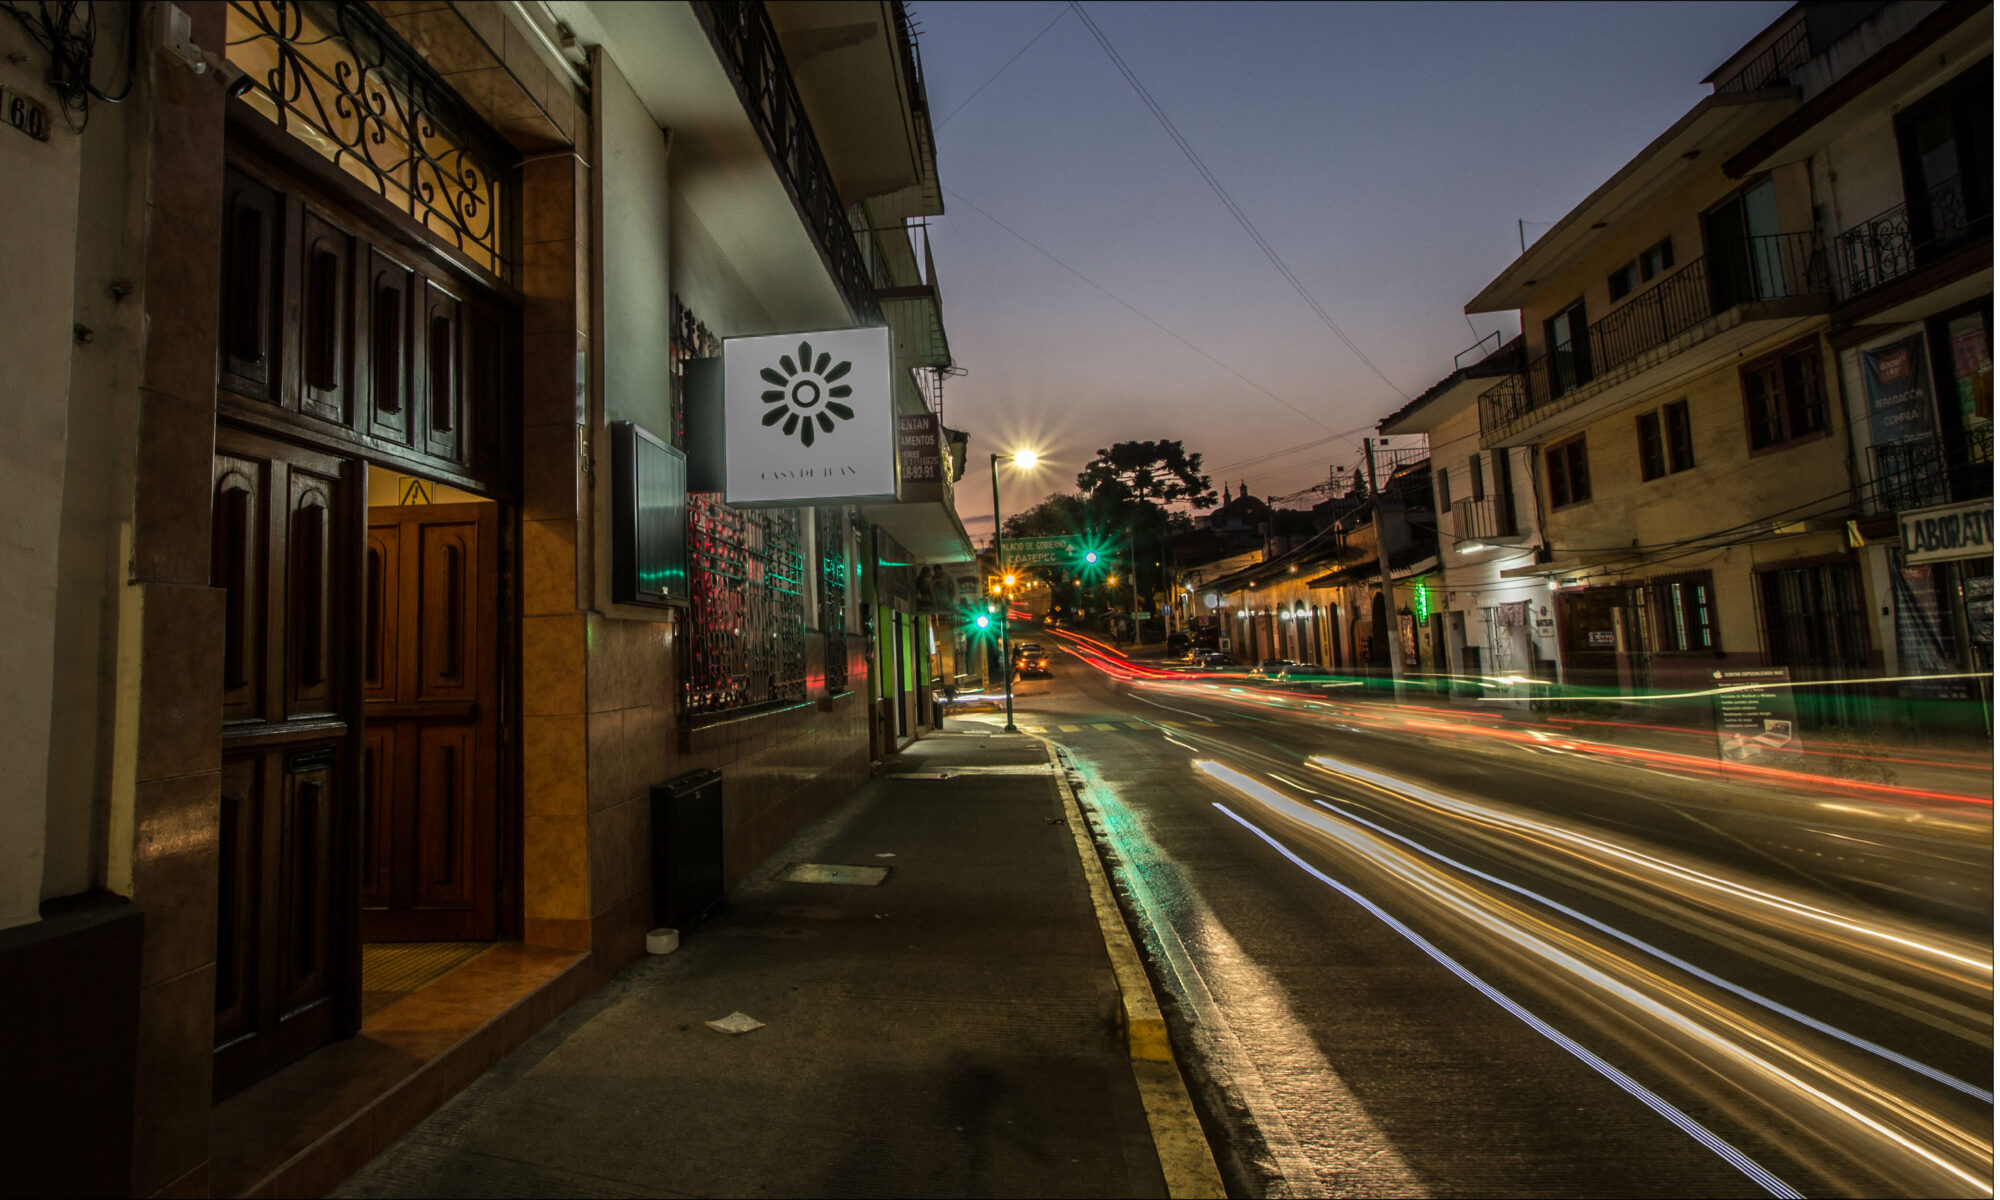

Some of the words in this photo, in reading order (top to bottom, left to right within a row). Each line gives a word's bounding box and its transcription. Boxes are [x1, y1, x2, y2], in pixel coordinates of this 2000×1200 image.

[899, 434, 935, 446] AMENTOS
[1002, 542, 1024, 551] ALACIO
[1026, 541, 1035, 550] DE
[1036, 539, 1067, 550] GOBIERNO
[1008, 552, 1057, 563] COATEPEC
